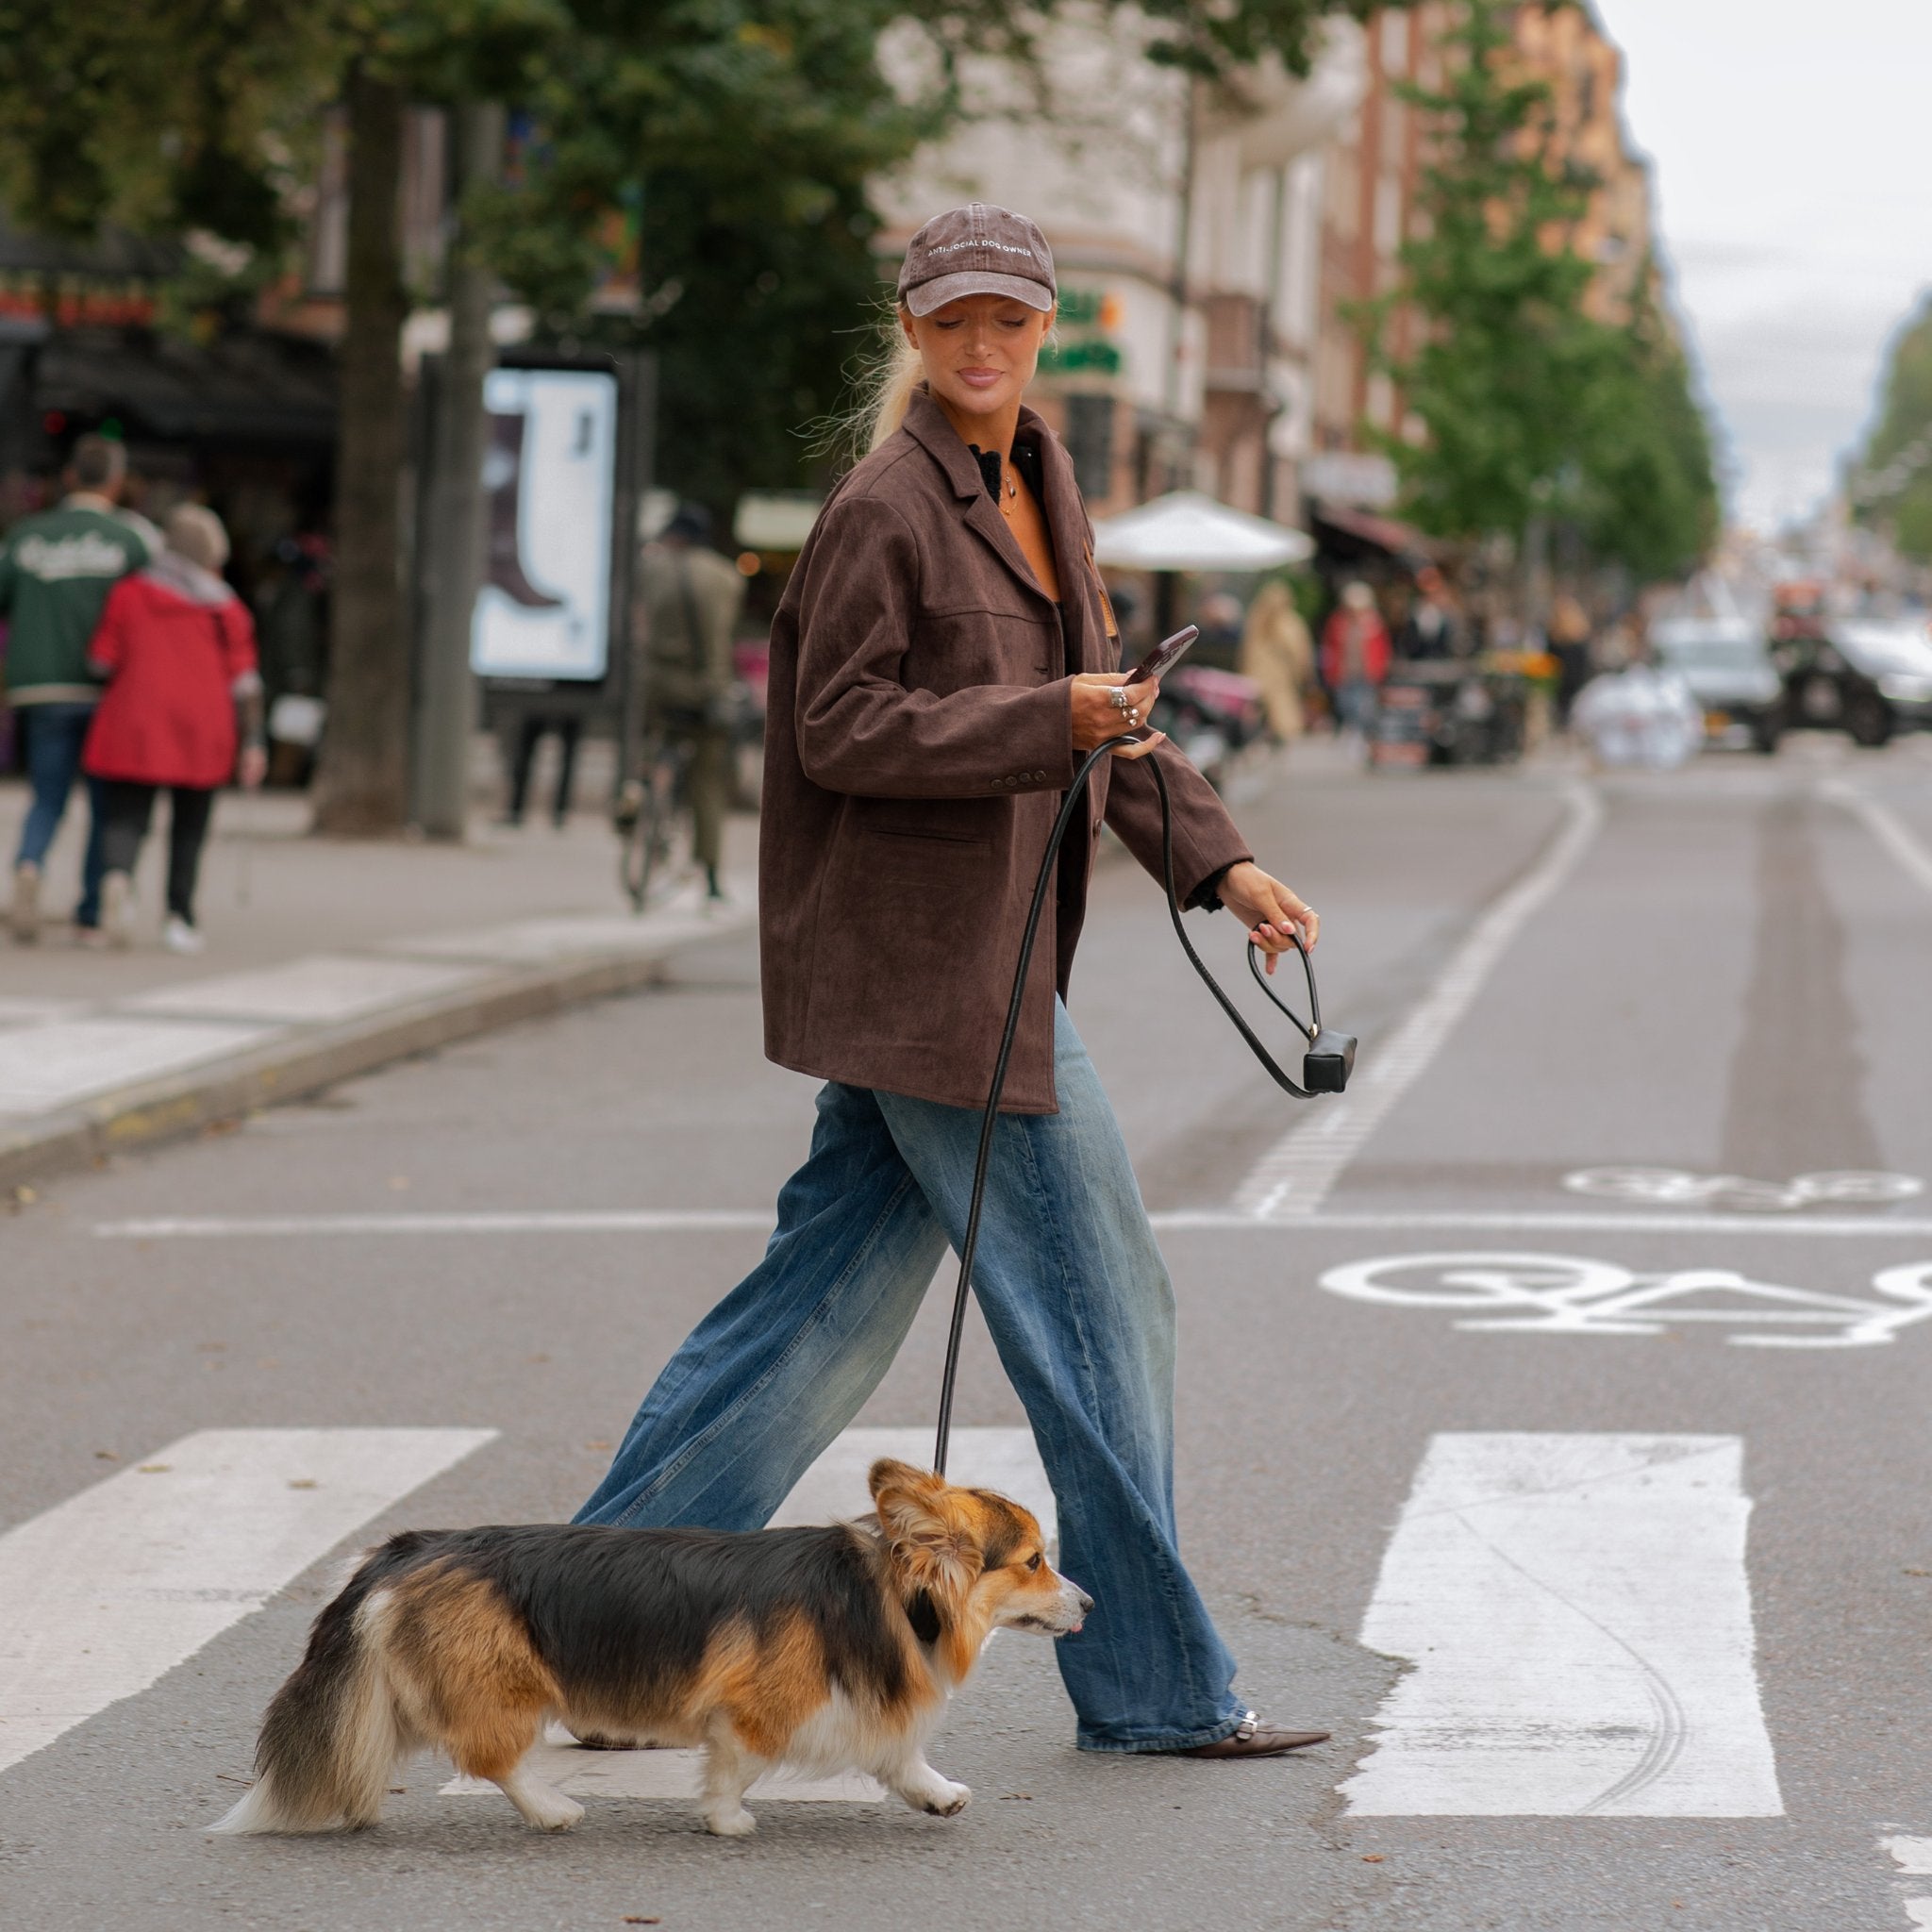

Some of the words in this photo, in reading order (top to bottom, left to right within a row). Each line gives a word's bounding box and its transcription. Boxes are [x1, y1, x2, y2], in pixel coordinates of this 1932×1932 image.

[928, 240, 979, 257] ANTI-SOCIAL
[981, 240, 1001, 249] DOG
[1002, 245, 1032, 257] OWNER
